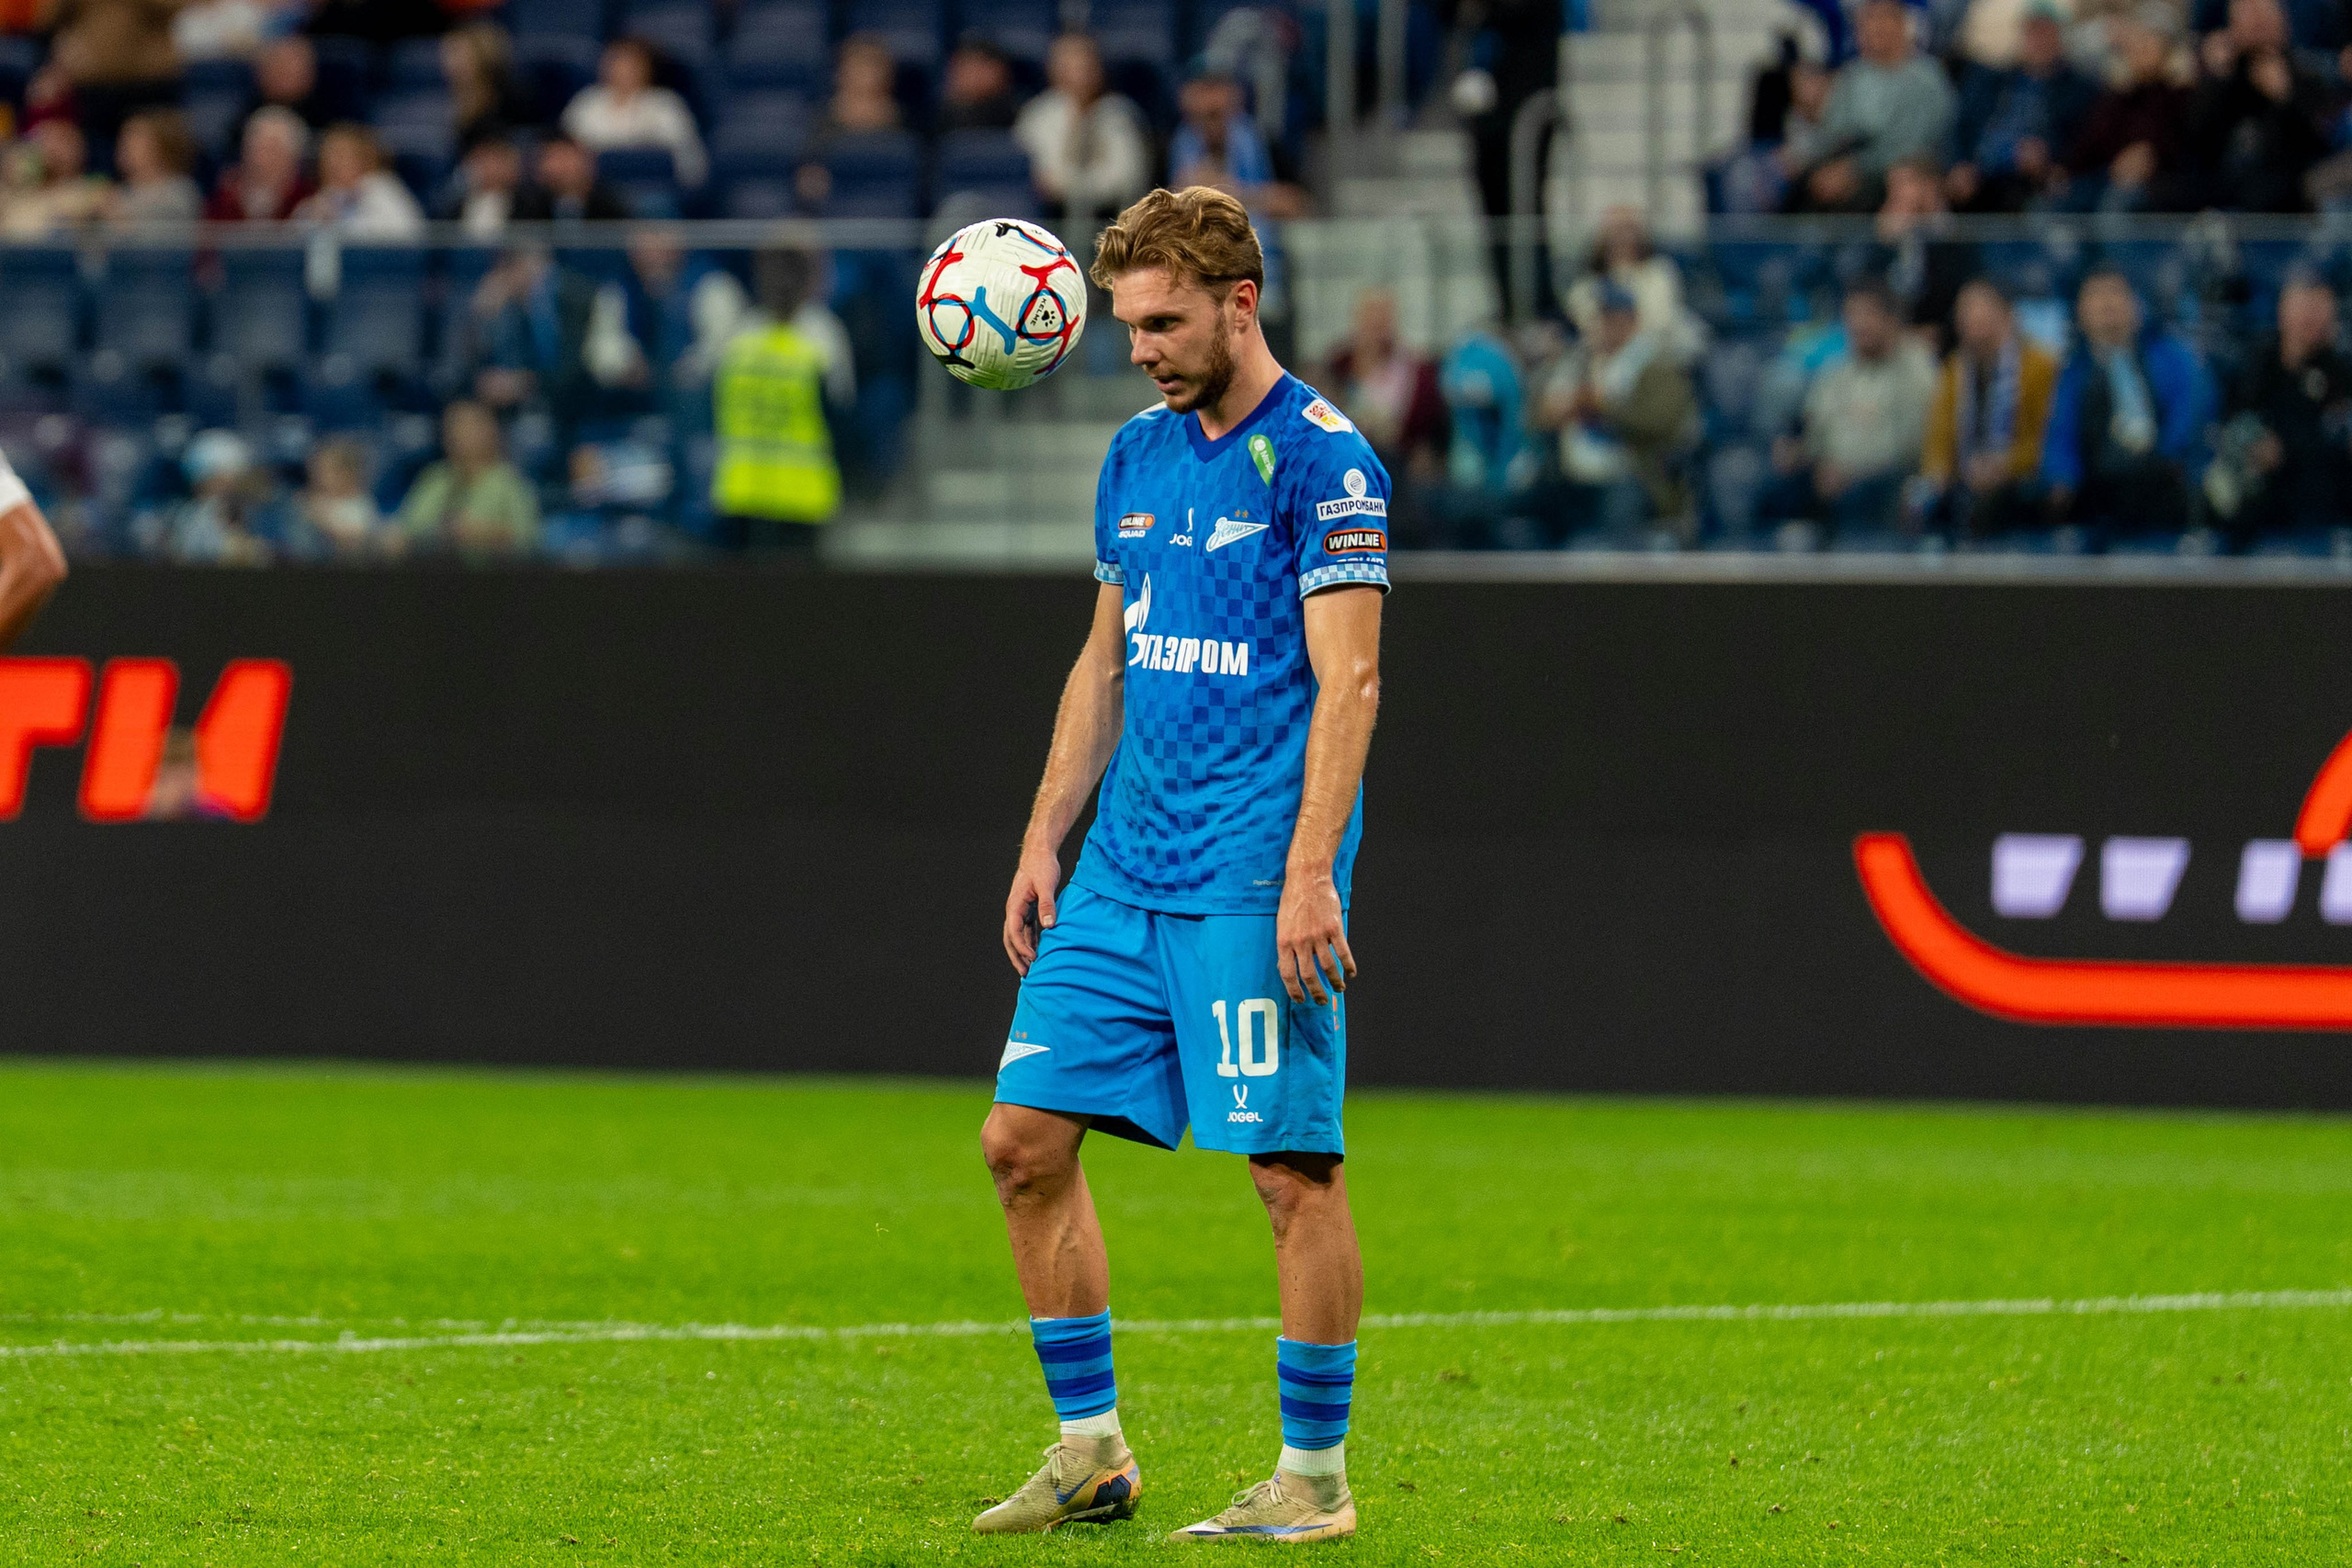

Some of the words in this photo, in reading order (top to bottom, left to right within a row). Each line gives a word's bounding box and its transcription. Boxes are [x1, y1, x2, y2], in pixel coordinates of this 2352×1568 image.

[1030, 298, 1046, 326] KELME
[1118, 530, 1147, 539] SQUAD
[1169, 533, 1193, 547] JOG
[1140, 633, 1249, 676] ГАЗПРОМ
[1212, 998, 1279, 1077] 10
